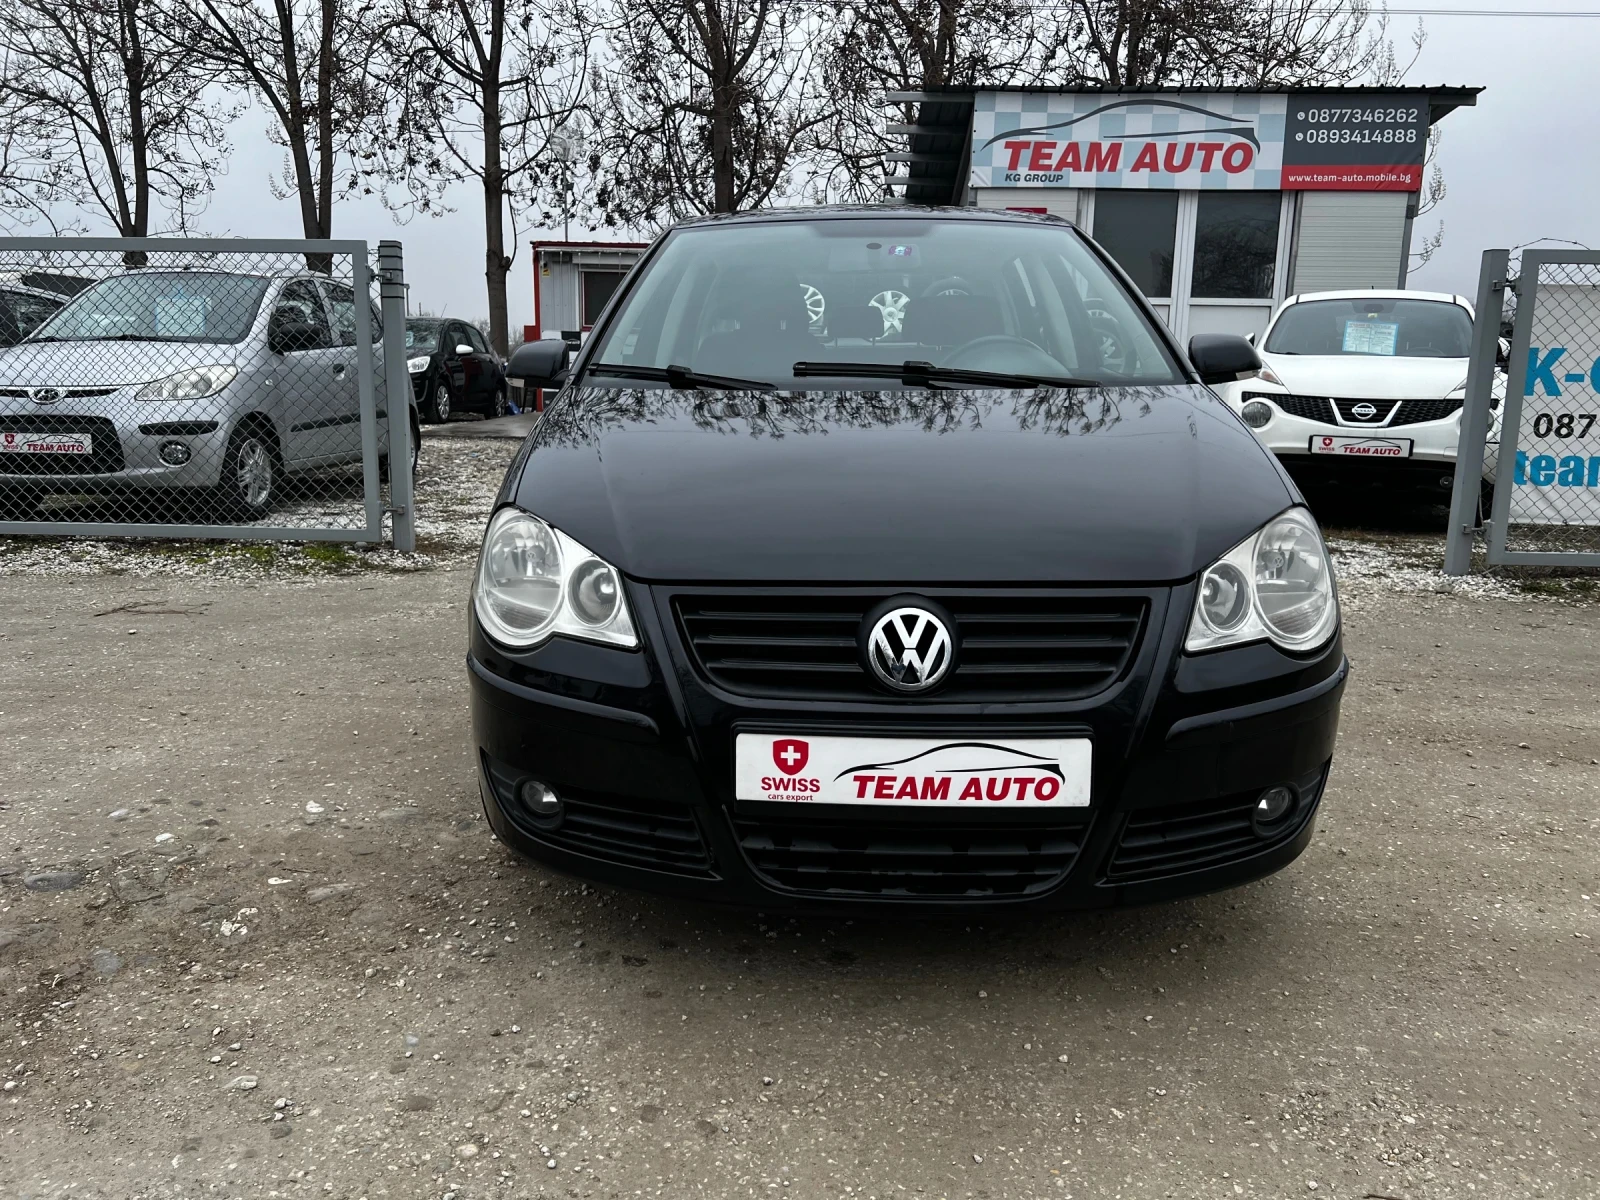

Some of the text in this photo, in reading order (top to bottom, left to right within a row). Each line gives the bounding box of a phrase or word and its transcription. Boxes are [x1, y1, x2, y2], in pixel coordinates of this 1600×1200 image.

[1308, 108, 1418, 123] 0877346262
[1306, 128, 1417, 143] 0893414888
[1003, 140, 1254, 174] TEAM AUTO
[1004, 173, 1063, 183] KG GROUP
[1288, 172, 1411, 183] www.team-auto.mobile.bg
[1533, 413, 1600, 439] 087
[27, 443, 84, 452] TEAM AUTO
[1343, 446, 1371, 455] TEAM
[1372, 447, 1401, 456] AUTO
[761, 776, 820, 793] SWISS
[853, 775, 1060, 801] TEAM AUTO
[785, 794, 813, 803] export
